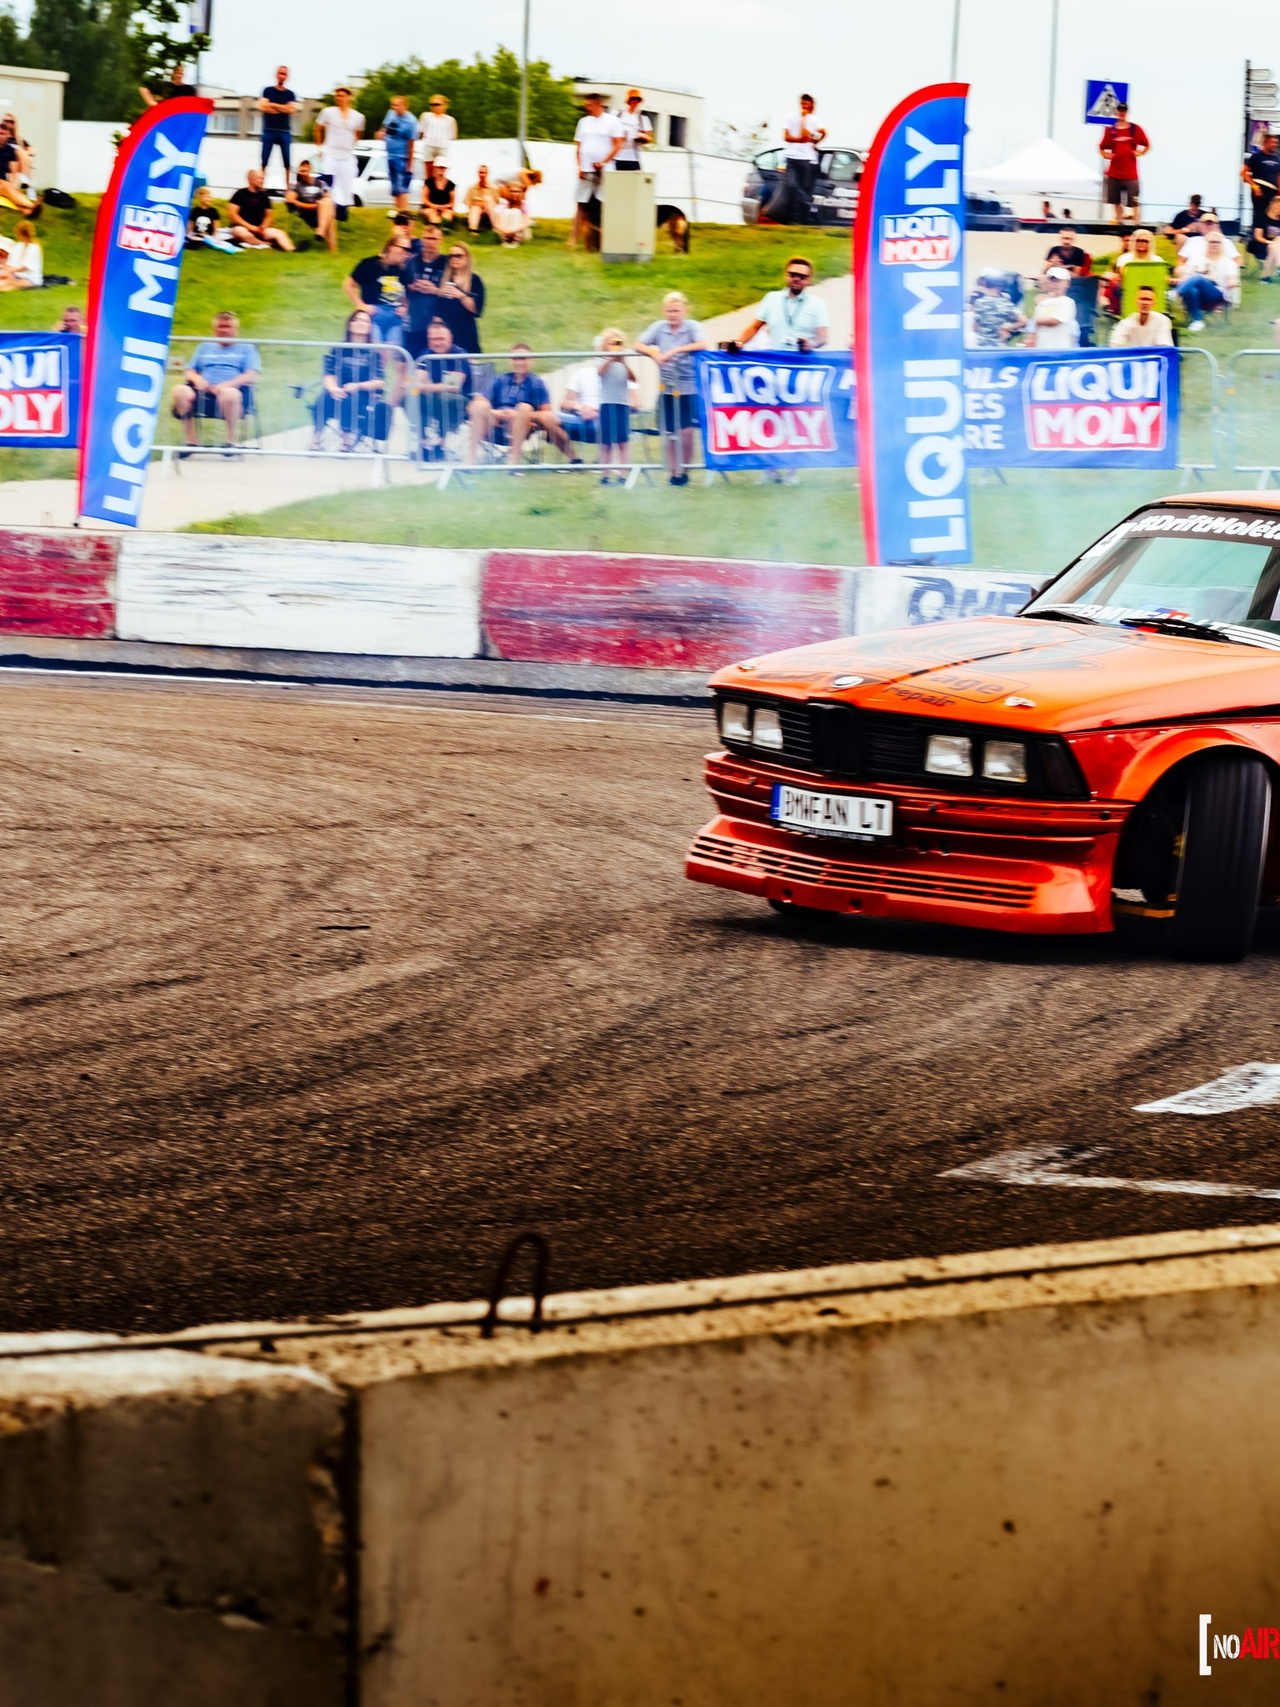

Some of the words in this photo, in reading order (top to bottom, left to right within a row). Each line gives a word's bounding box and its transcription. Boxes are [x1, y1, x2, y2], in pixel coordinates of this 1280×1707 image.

[883, 216, 950, 239] LIQUI
[882, 238, 950, 262] MOLY
[710, 366, 827, 405] LIQUI
[1032, 361, 1159, 402] LIQUI
[102, 336, 169, 516] LIQUI
[713, 409, 827, 448] MOLY
[1033, 405, 1162, 446] MOLY
[903, 359, 967, 553] LIQUI
[883, 687, 955, 707] repair
[859, 800, 887, 831] LT
